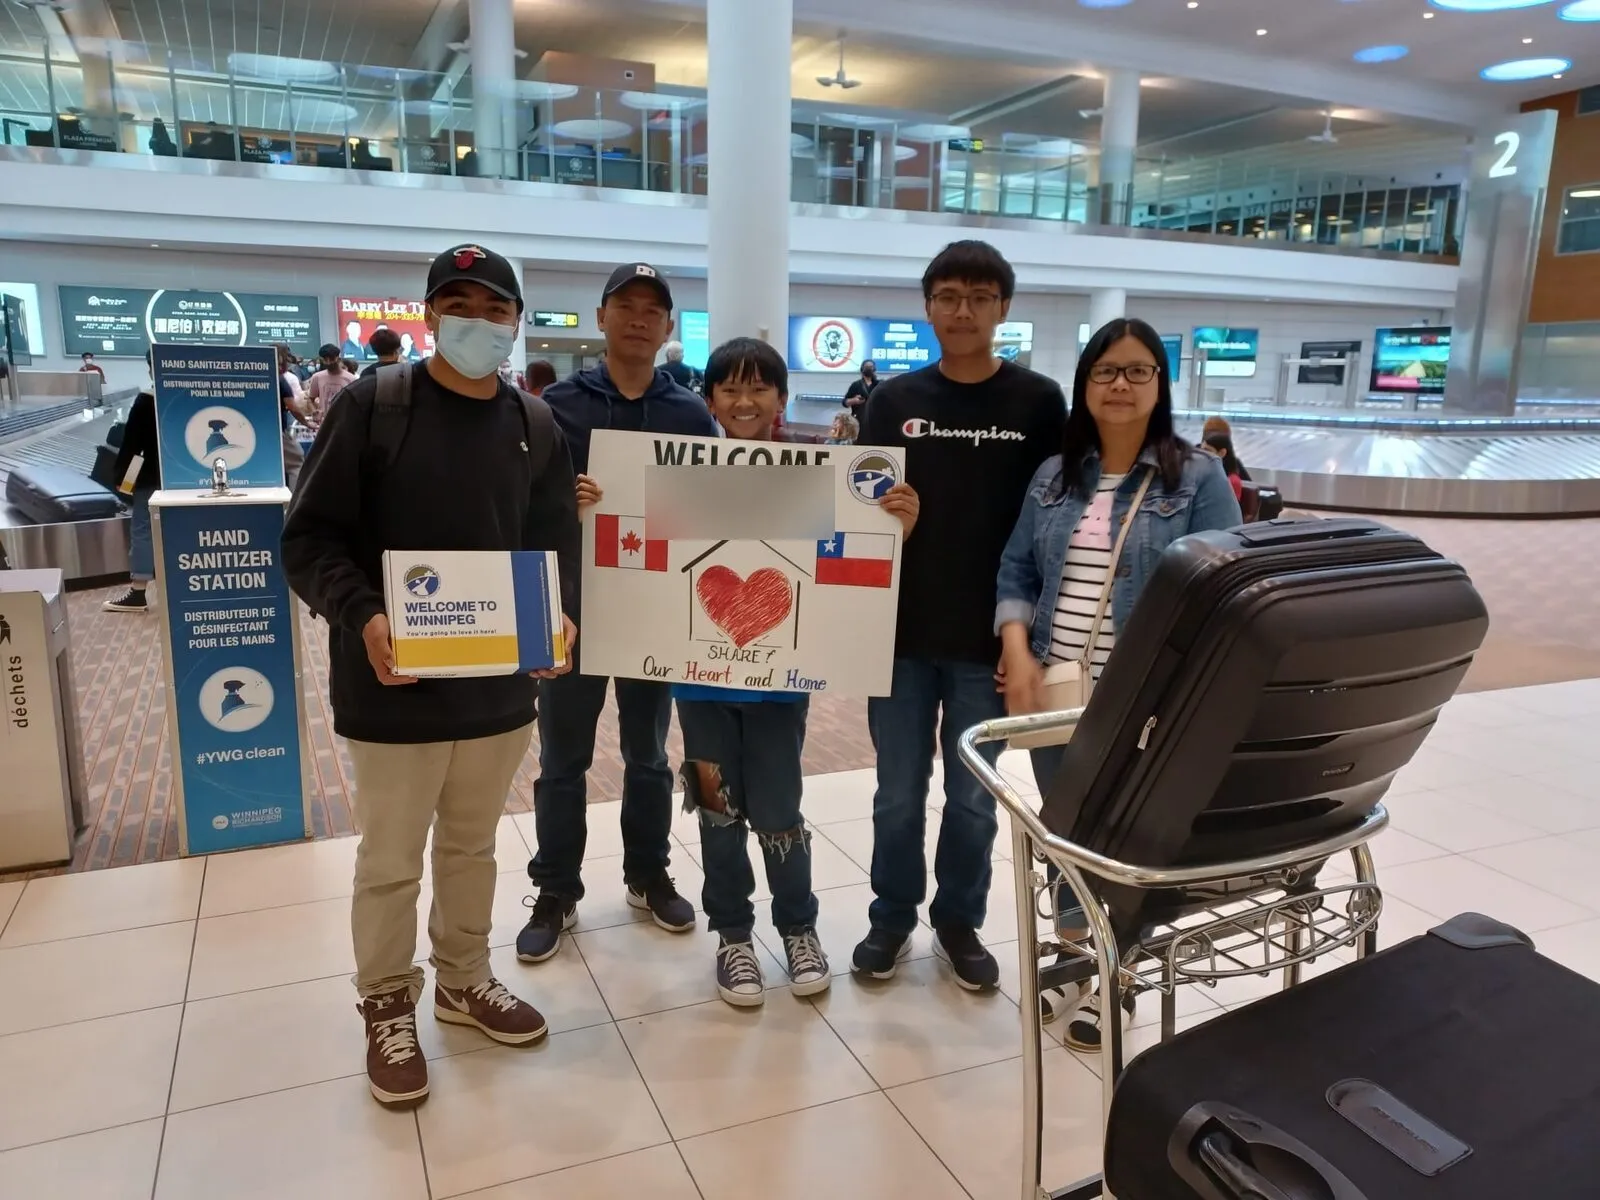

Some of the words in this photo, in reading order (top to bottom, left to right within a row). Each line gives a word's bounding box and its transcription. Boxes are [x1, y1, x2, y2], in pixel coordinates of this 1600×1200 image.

[1489, 131, 1520, 178] 2
[342, 299, 381, 313] BARRY
[383, 301, 407, 313] LEE
[161, 360, 186, 368] HAND
[188, 360, 231, 369] SANITIZER
[233, 361, 269, 370] STATION
[163, 381, 211, 389] DISTRIBUTEUR
[212, 381, 221, 389] DE
[222, 380, 270, 390] DÉSINFECTANT
[902, 418, 1026, 447] Champion
[198, 529, 250, 547] HAND
[178, 550, 273, 570] SANITIZER
[188, 572, 266, 591] STATION
[405, 601, 476, 613] WELCOME
[478, 600, 497, 611] TO
[184, 608, 259, 622] DISTRIBUTEUR
[262, 607, 276, 617] DE
[405, 614, 476, 626] WINNIPEG
[192, 621, 270, 635] DÉSINFECTANT
[188, 638, 217, 649] POUR
[220, 636, 239, 647] LES
[241, 634, 276, 645] MAINS
[643, 655, 673, 678] Our
[682, 660, 733, 684] Heart
[744, 668, 774, 688] and
[783, 668, 827, 690] Home
[8, 655, 29, 728] déchets
[231, 806, 282, 819] WINNIPEG
